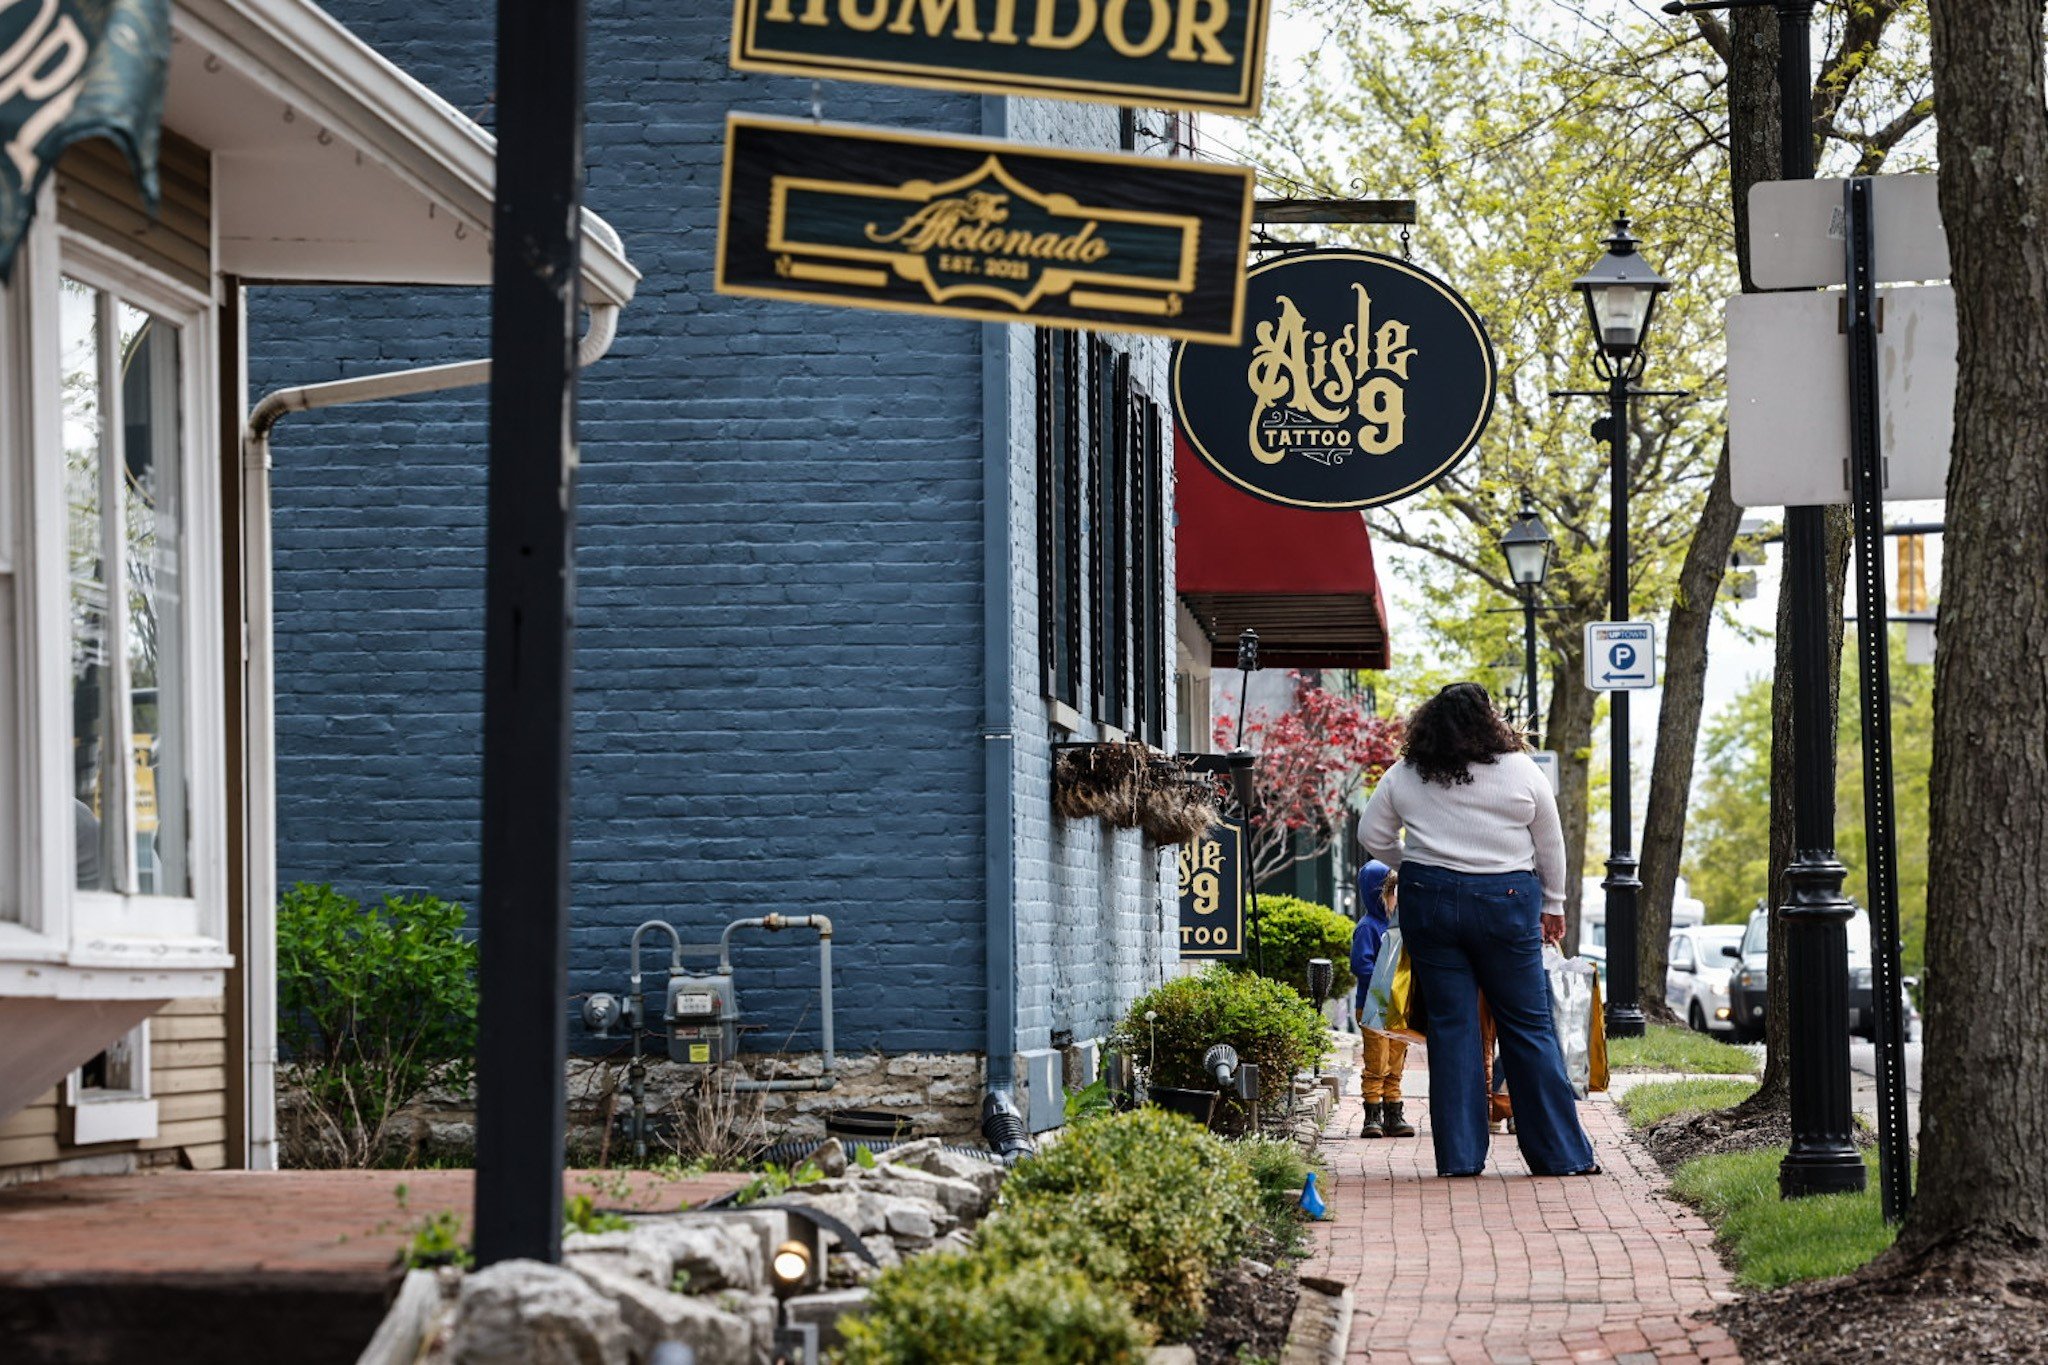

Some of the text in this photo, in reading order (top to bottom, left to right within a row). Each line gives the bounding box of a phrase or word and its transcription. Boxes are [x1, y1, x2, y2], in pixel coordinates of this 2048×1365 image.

[764, 0, 1235, 65] MIDOR
[864, 198, 1110, 262] Aficionado
[939, 253, 980, 274] EST.
[1247, 281, 1419, 465] Aisle
[1264, 429, 1351, 447] TATTOO
[1356, 376, 1406, 456] 9
[1615, 647, 1632, 666] P
[1178, 834, 1227, 887] sle
[1191, 872, 1220, 915] 9
[1179, 926, 1228, 945] TOO
